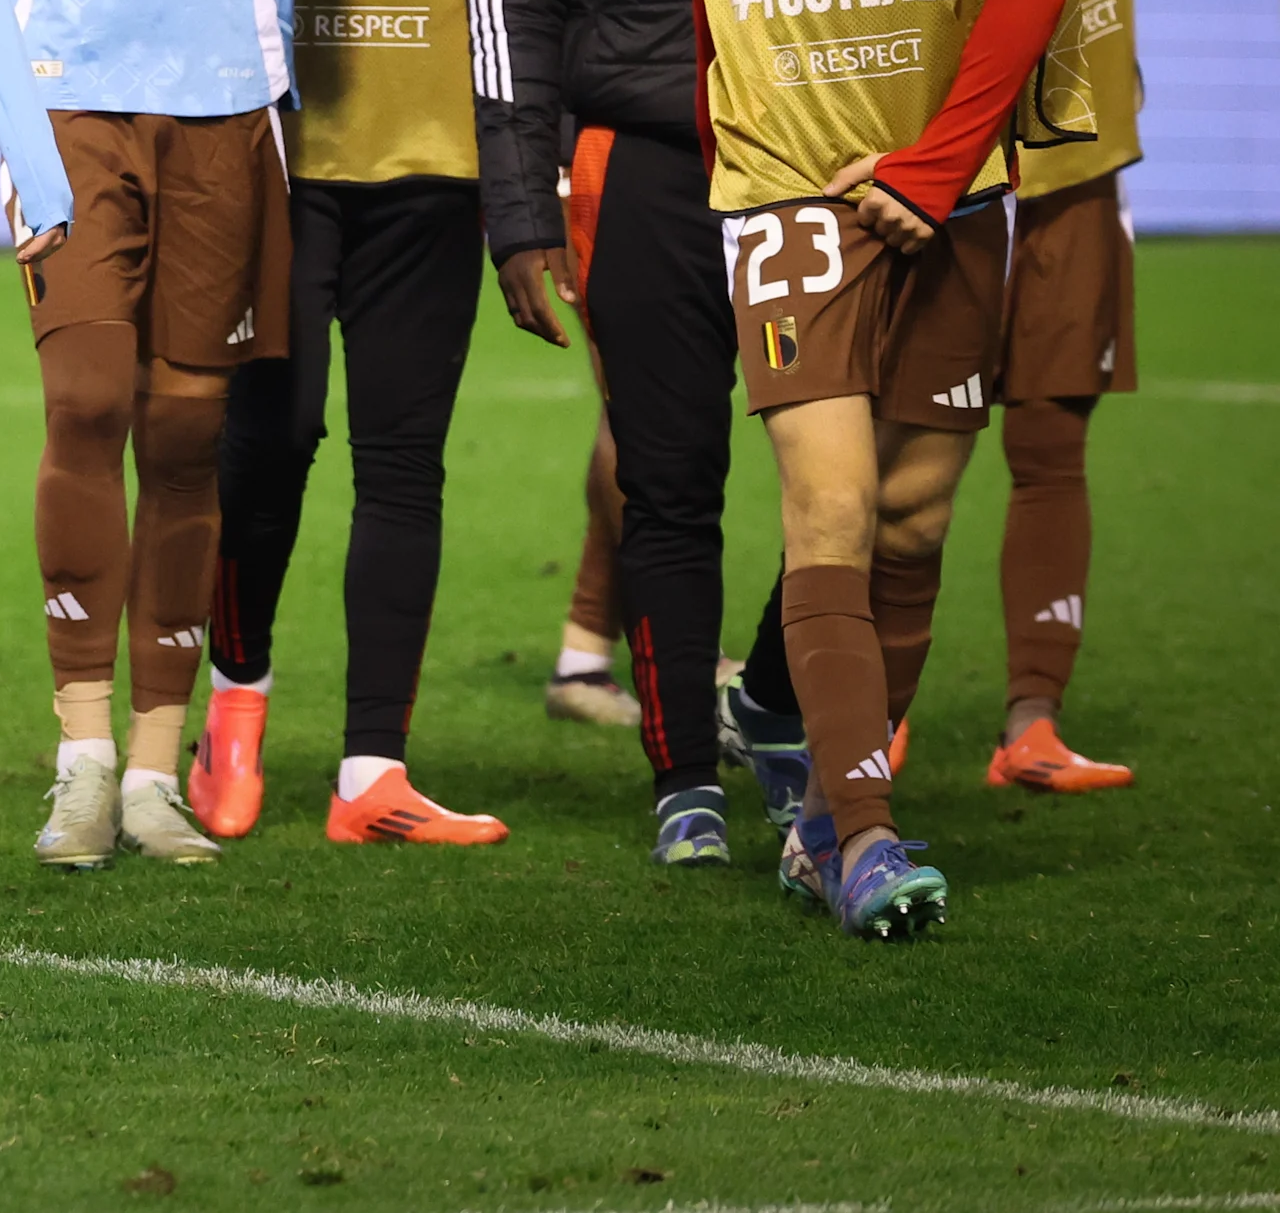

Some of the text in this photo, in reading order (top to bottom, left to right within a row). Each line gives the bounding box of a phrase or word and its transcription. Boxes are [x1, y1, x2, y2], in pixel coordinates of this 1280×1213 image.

[315, 14, 429, 38] RESPECT
[809, 38, 922, 74] RESPECT
[740, 207, 843, 306] 23
